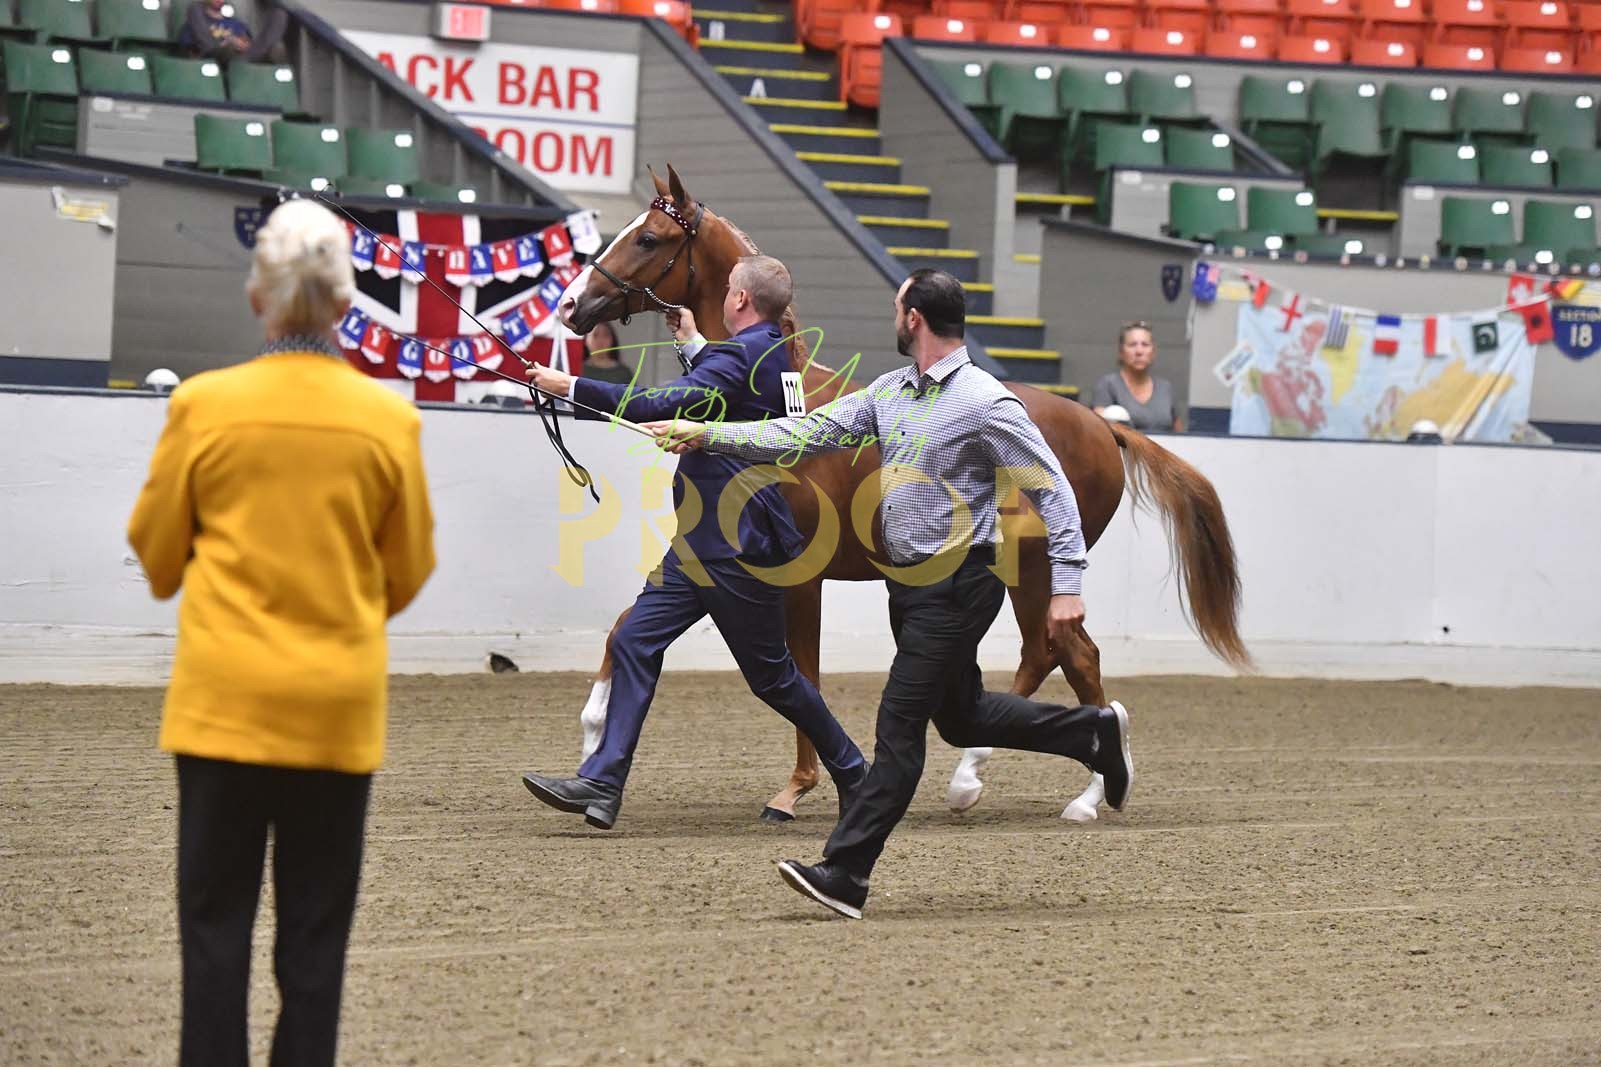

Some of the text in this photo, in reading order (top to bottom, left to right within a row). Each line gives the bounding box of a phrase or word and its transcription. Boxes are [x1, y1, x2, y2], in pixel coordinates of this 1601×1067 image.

[496, 61, 600, 112] BAR
[470, 124, 614, 178] OOM
[400, 333, 494, 367] GOOD
[1570, 323, 1593, 349] 18
